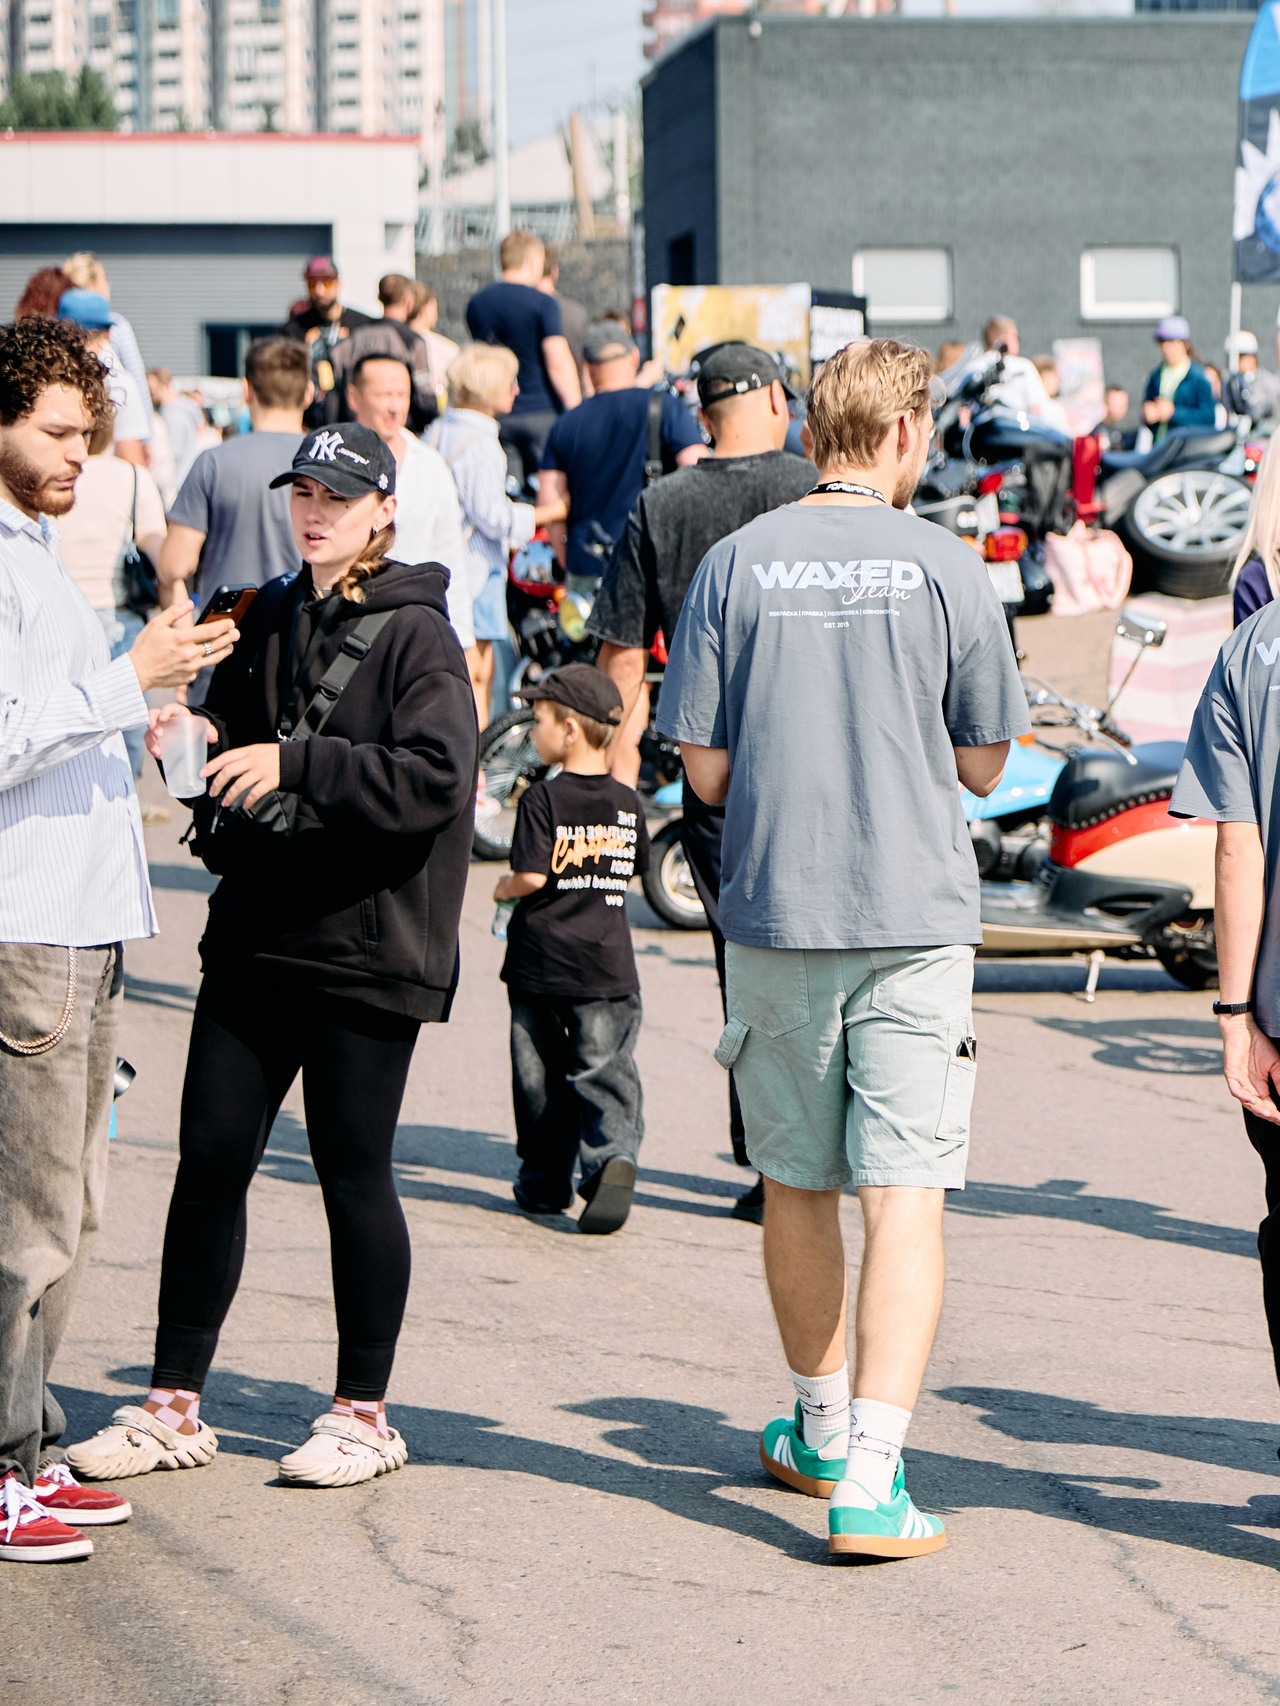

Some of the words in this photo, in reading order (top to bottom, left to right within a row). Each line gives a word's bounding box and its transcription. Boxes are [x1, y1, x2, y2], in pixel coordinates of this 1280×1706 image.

[309, 431, 344, 461] NY
[826, 483, 874, 496] FORWARD
[751, 559, 924, 590] WAXED
[838, 568, 911, 605] Team
[862, 609, 900, 617] ШИНОМОНТЖ
